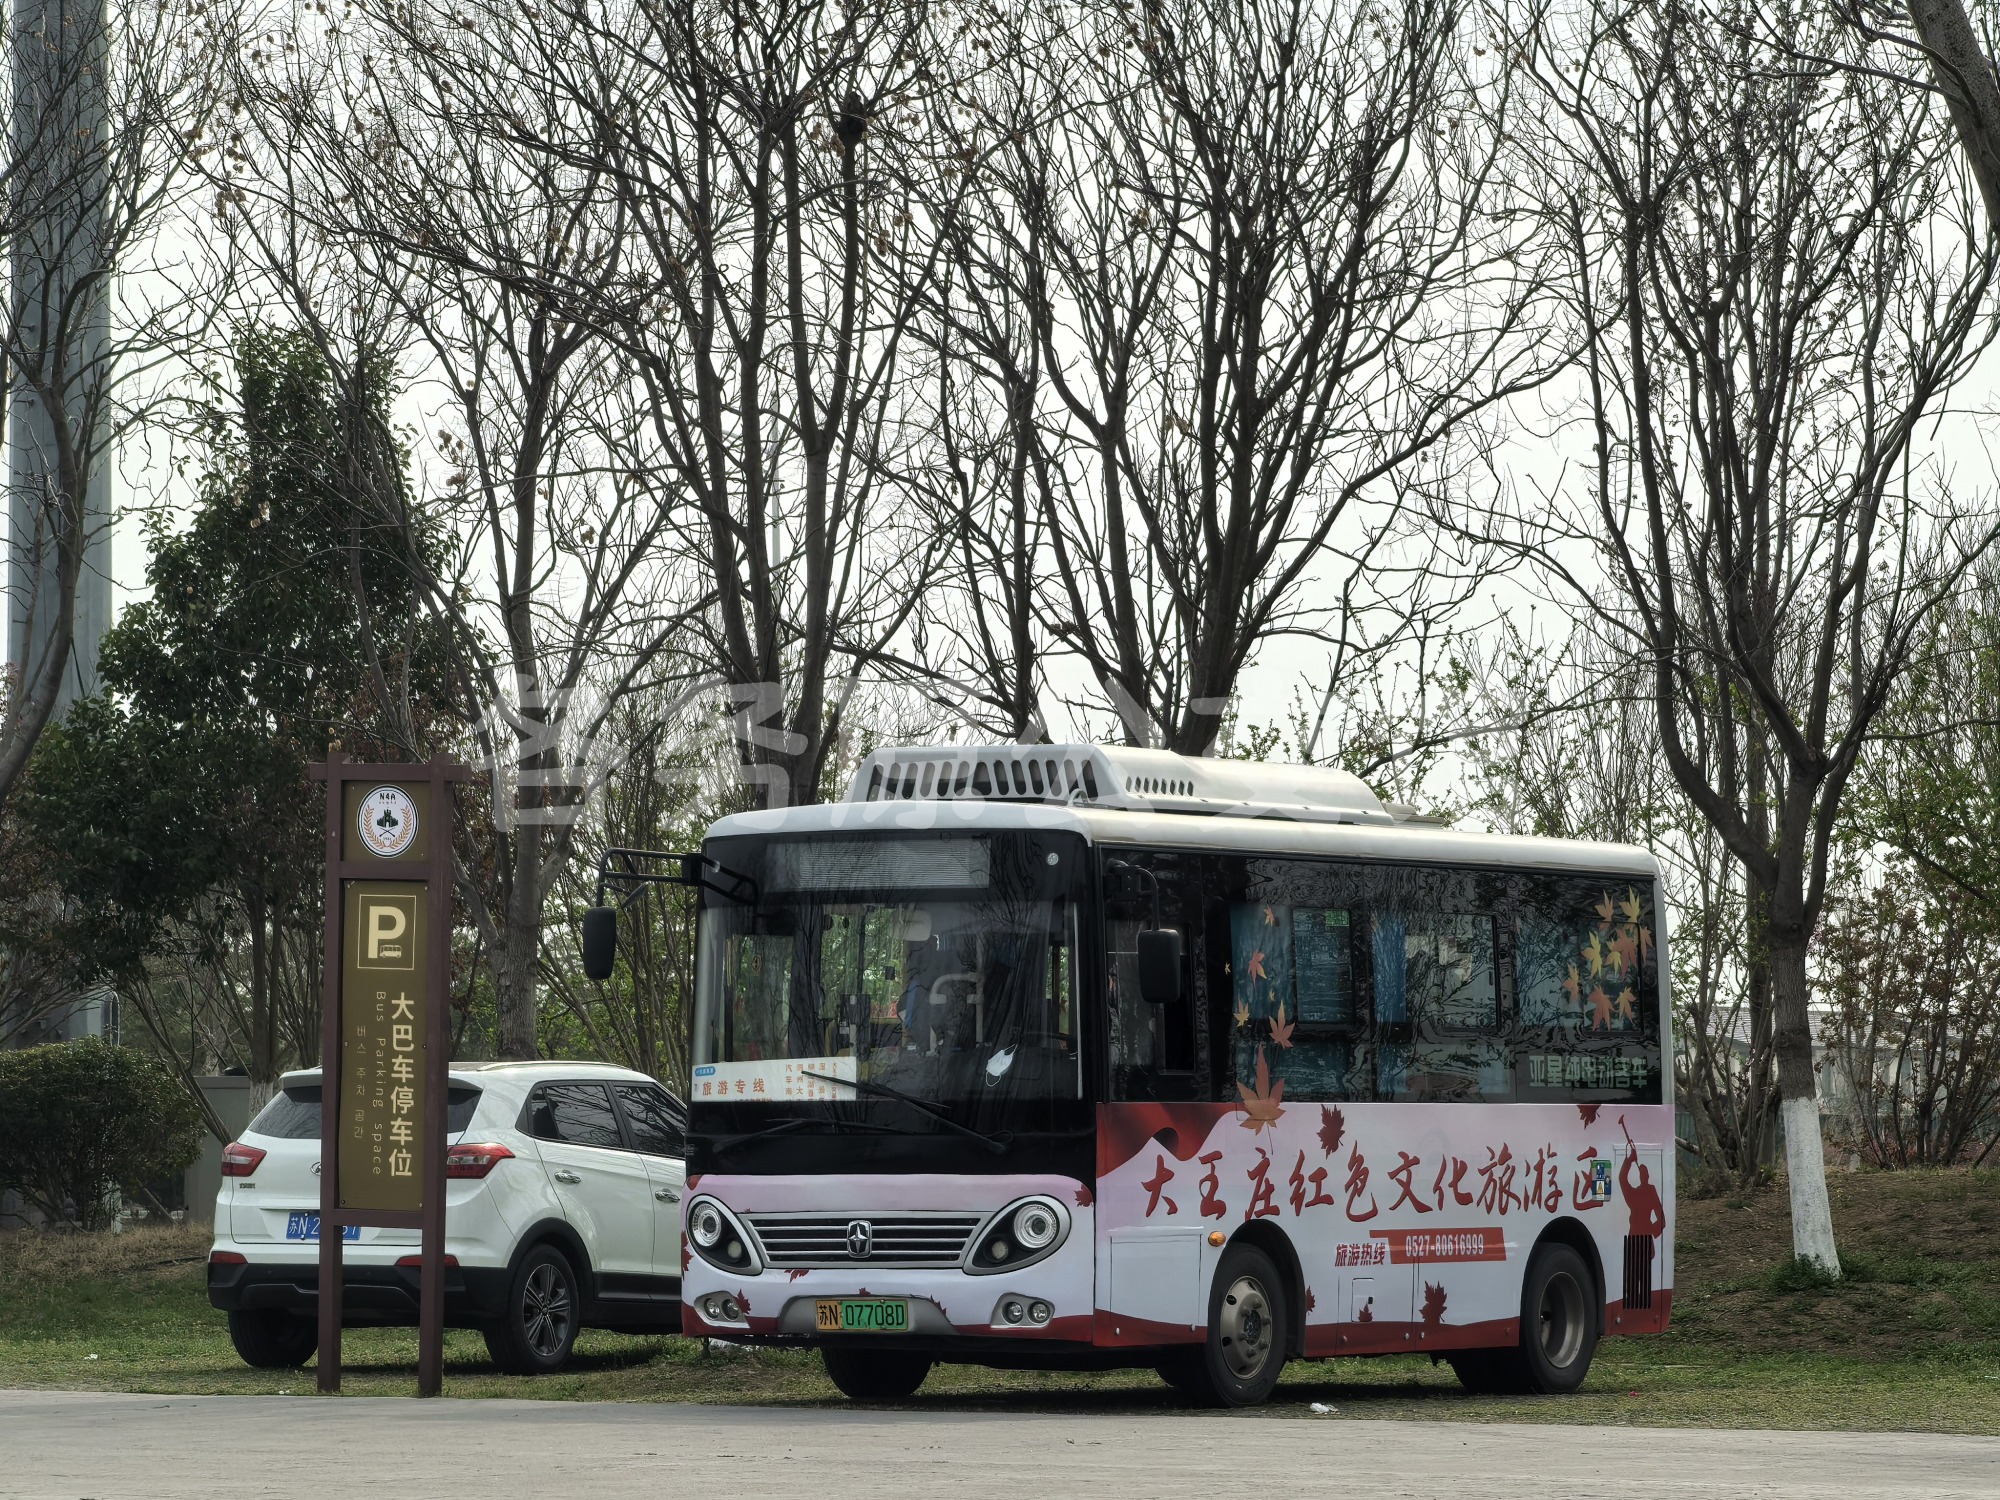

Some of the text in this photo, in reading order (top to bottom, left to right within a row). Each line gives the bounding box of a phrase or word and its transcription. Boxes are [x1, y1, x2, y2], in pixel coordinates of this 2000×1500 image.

[379, 792, 396, 801] N4A
[367, 905, 407, 959] P
[354, 1025, 367, 1139] 버스 주차 공간
[371, 991, 387, 1175] Bus Parking space
[388, 991, 415, 1177] 大巴车停车位
[702, 1077, 766, 1097] 旅游专线
[1140, 1140, 1604, 1223] 大王庄红色文化旅游区
[1335, 1242, 1386, 1267] 旅游热线
[1405, 1233, 1484, 1257] 0527-80616999
